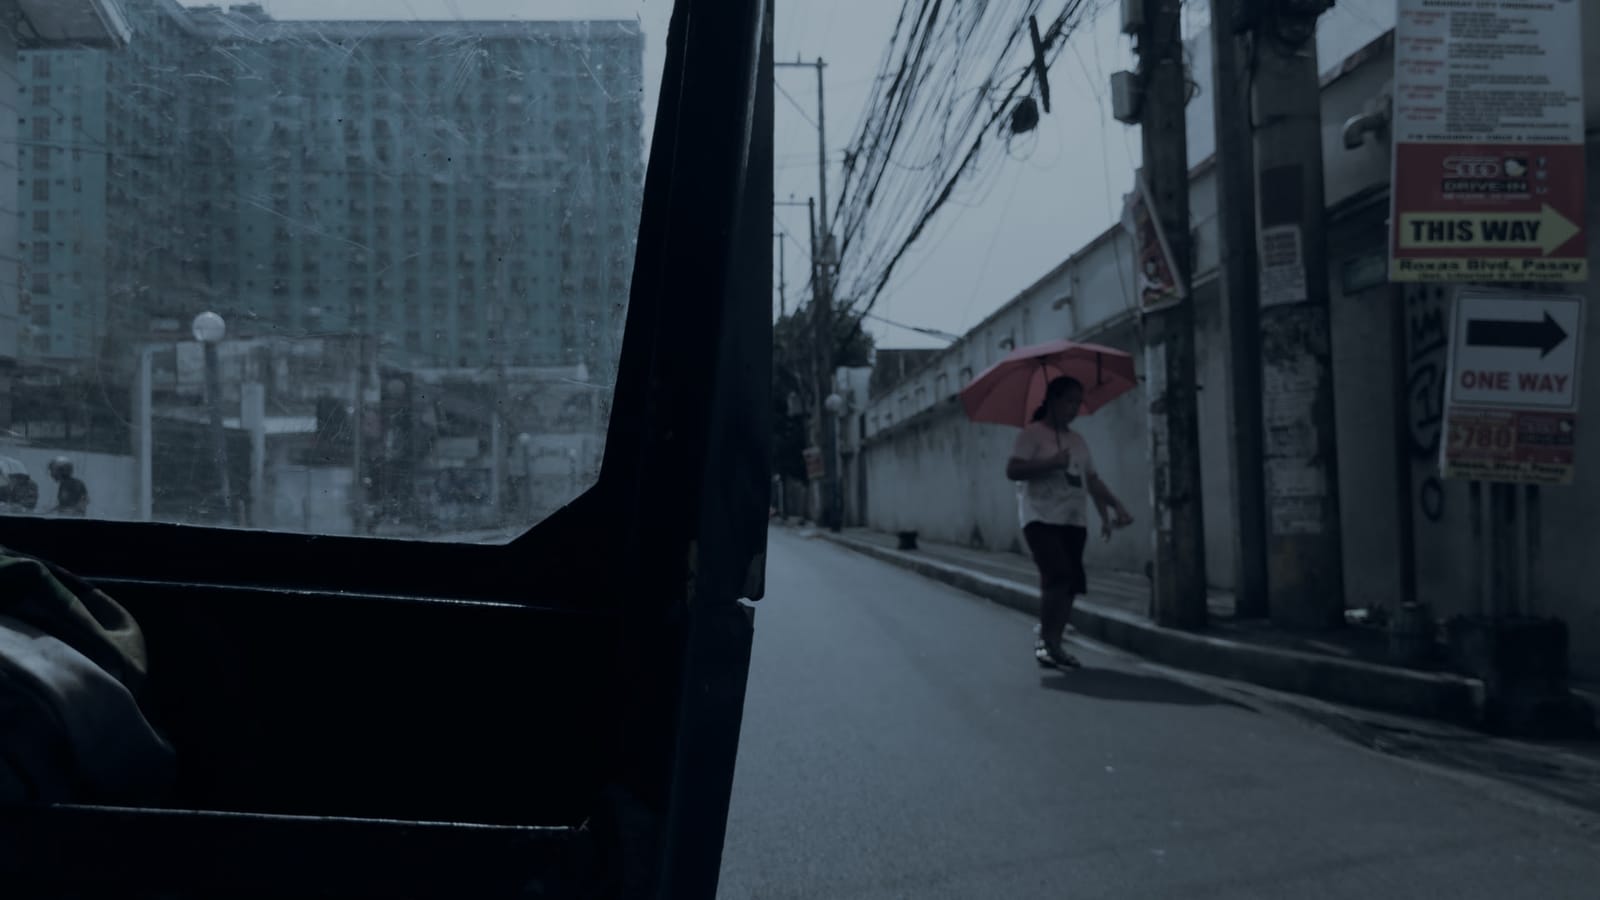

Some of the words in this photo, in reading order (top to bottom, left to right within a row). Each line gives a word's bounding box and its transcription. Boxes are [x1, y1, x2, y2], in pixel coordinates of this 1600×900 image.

[1444, 181, 1526, 191] DRIVE-IN
[1411, 220, 1473, 241] THIS
[1481, 220, 1540, 241] WAY
[1400, 259, 1459, 271] Roxas
[1523, 260, 1581, 273] Pasay
[1461, 371, 1510, 390] ONE
[1518, 374, 1568, 392] WAY
